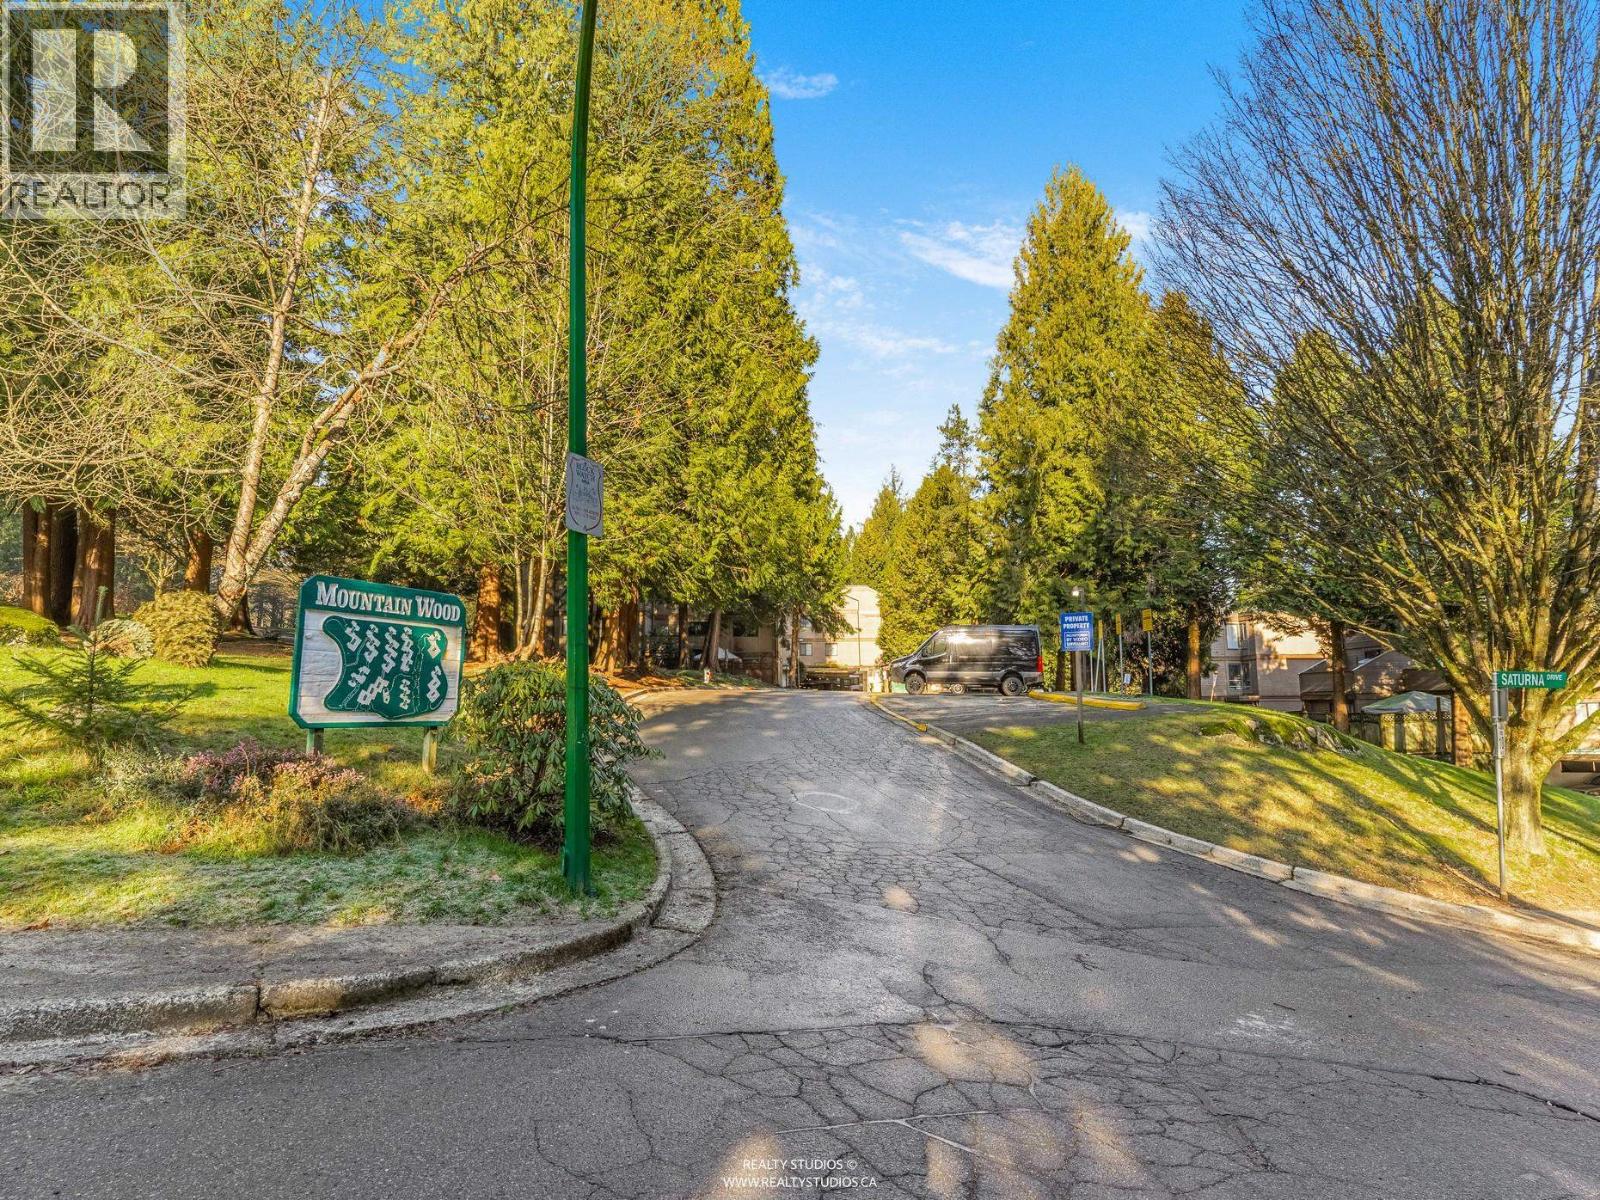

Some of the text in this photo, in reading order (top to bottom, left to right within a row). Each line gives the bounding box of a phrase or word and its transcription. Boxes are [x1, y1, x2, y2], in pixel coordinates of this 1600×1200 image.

[315, 581, 461, 622] MOUNTAIN WOOD
[1501, 673, 1545, 686] SATURNA
